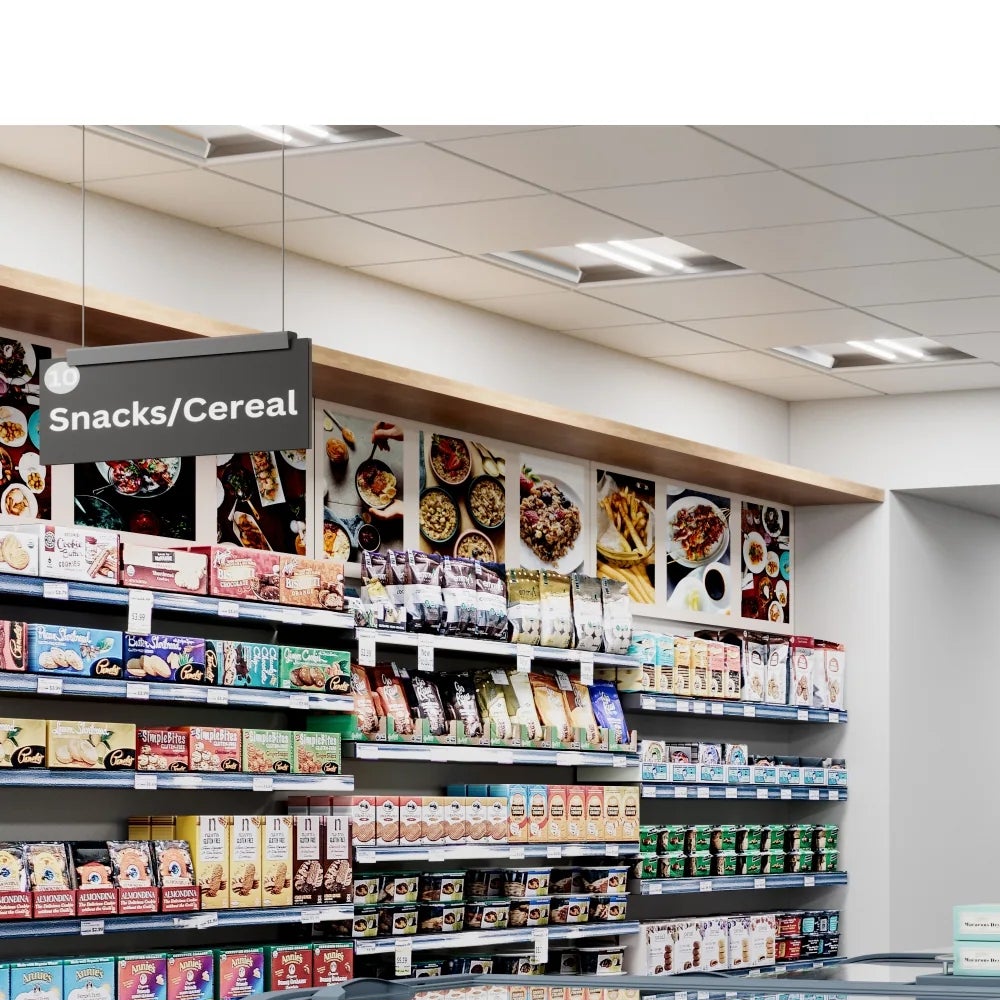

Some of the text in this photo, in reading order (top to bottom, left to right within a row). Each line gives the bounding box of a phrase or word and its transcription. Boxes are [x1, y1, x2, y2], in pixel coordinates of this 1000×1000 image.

[48, 366, 78, 389] 10
[49, 389, 298, 432] Snacks/Cereal
[35, 894, 73, 903] ALMONDINA
[79, 893, 115, 901] ALMONDINA
[121, 892, 155, 900] ALMONDINA
[164, 890, 197, 898] ALMONDINA
[231, 955, 253, 968] Annie's
[282, 952, 303, 964] Annie's
[323, 952, 344, 962] Annie's
[75, 966, 104, 978] Annie's
[131, 961, 156, 974] Annie's
[23, 970, 52, 983] Annie's
